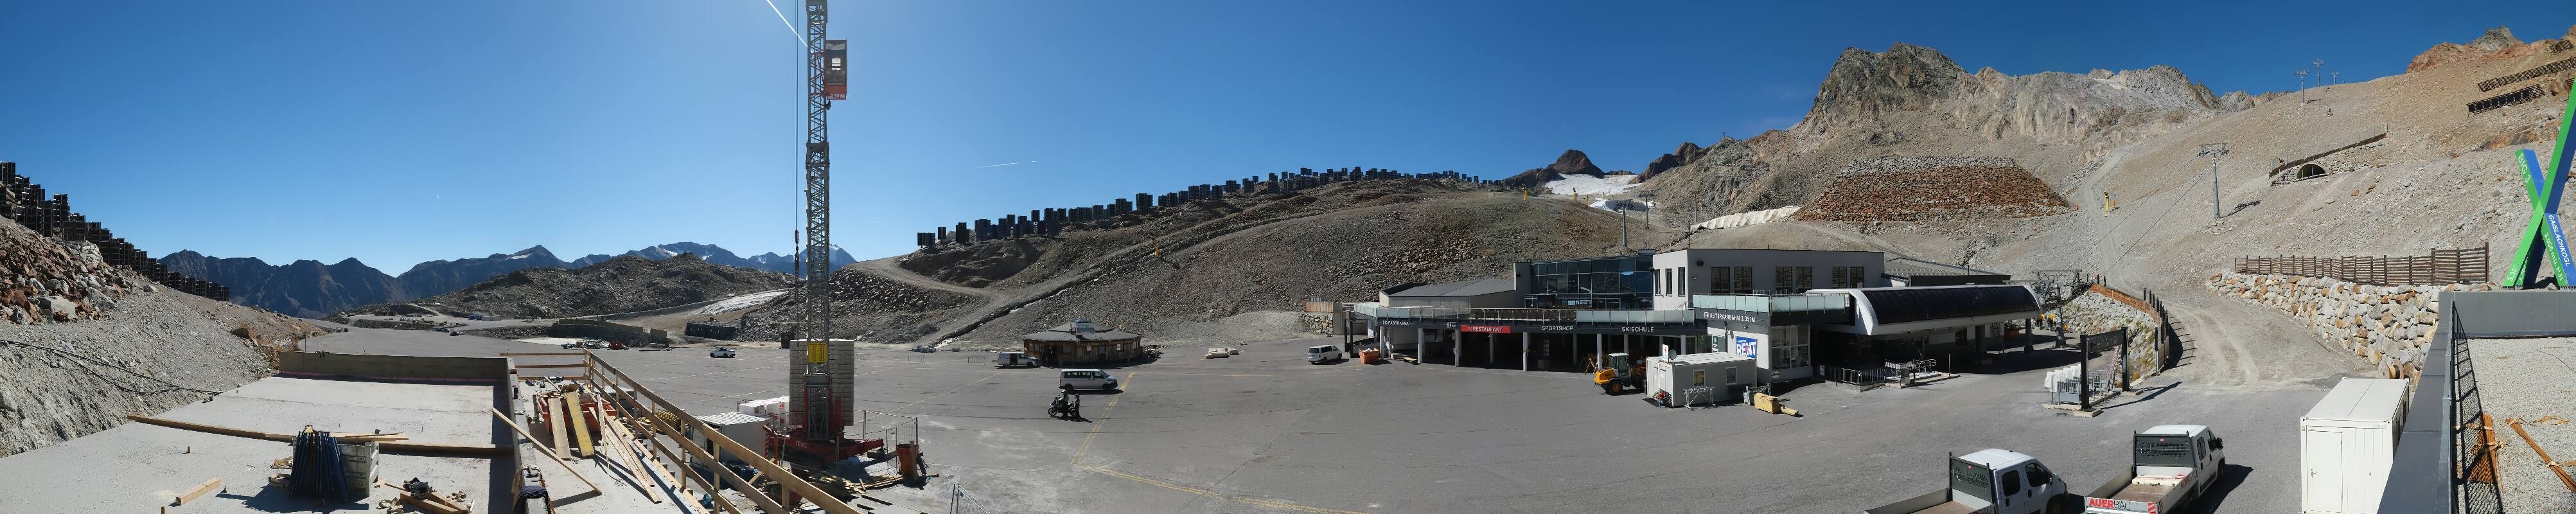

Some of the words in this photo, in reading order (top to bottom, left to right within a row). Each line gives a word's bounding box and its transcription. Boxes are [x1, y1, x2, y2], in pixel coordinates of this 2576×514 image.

[2518, 153, 2528, 175] BIG
[2525, 174, 2531, 183] 3
[2549, 215, 2571, 267] GAISLACHKOGL
[1736, 342, 1756, 356] RENT
